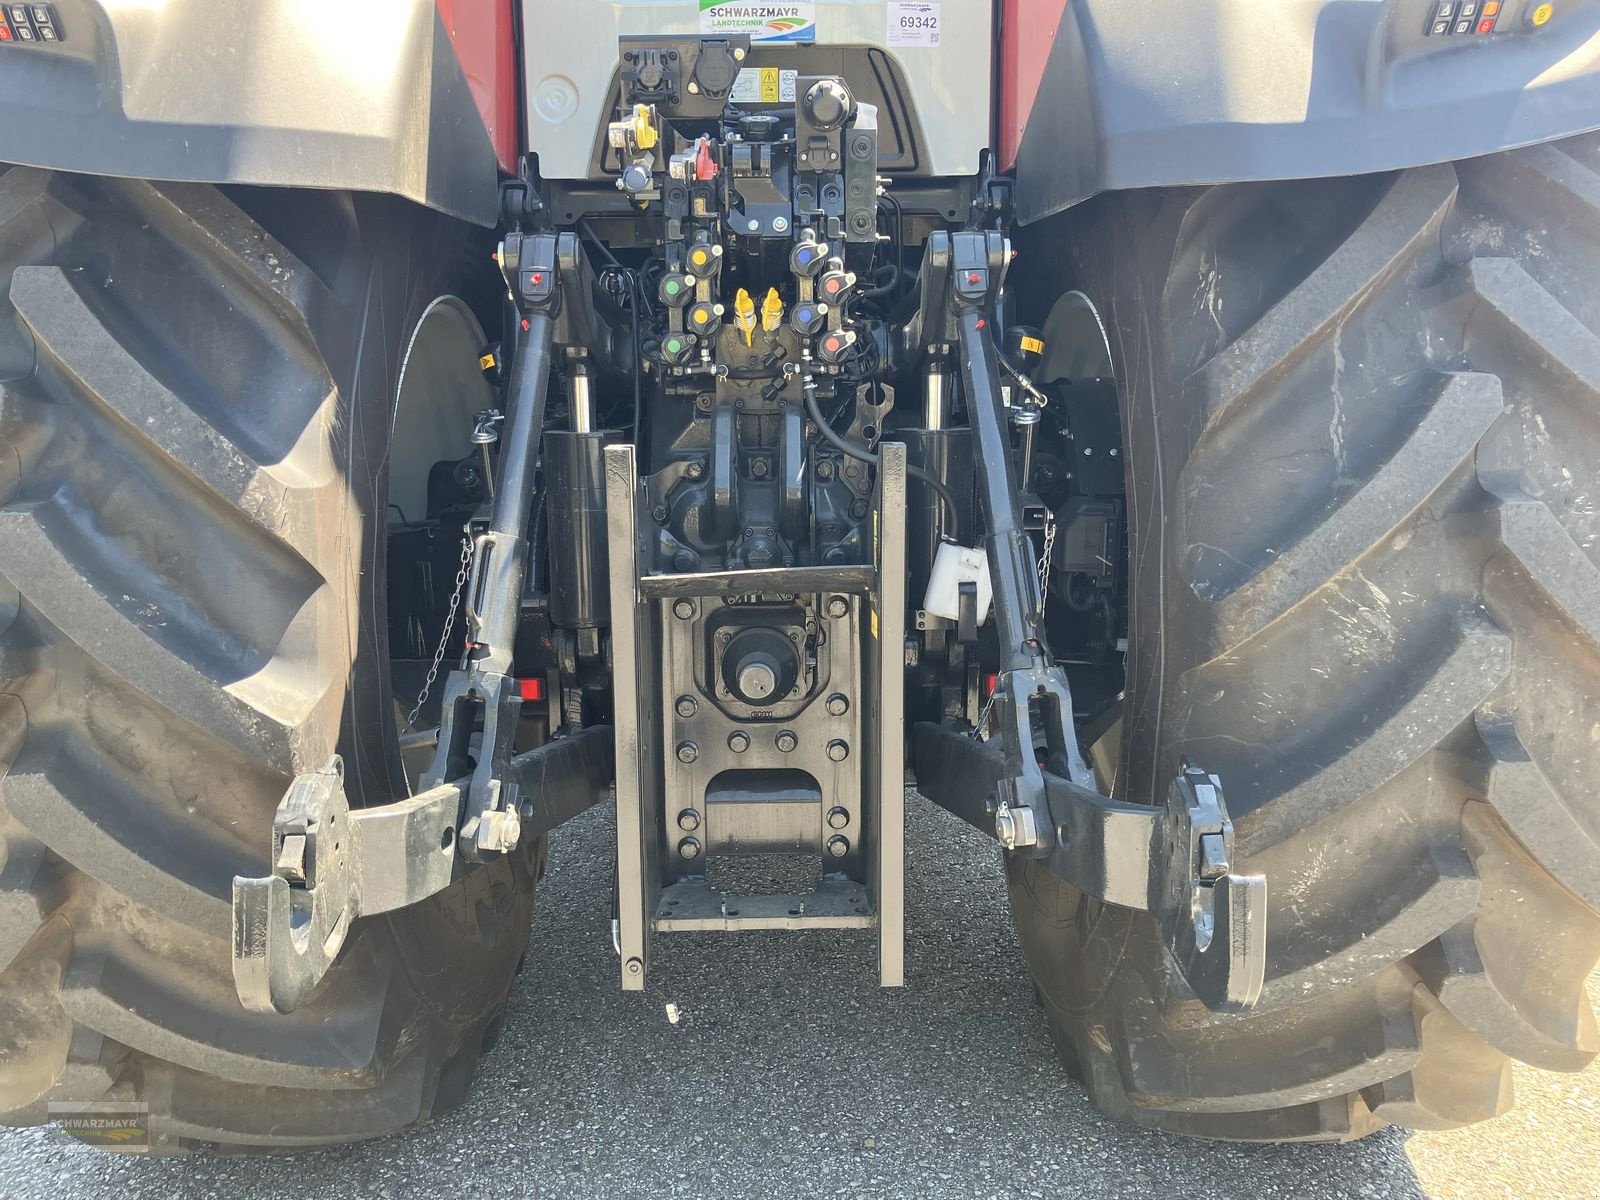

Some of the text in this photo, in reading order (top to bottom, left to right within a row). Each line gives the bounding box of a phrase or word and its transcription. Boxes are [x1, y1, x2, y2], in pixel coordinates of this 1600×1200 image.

[709, 7, 799, 17] SCHWARZMAYR
[712, 19, 764, 27] LANDTECHNIK
[900, 16, 937, 29] 69342
